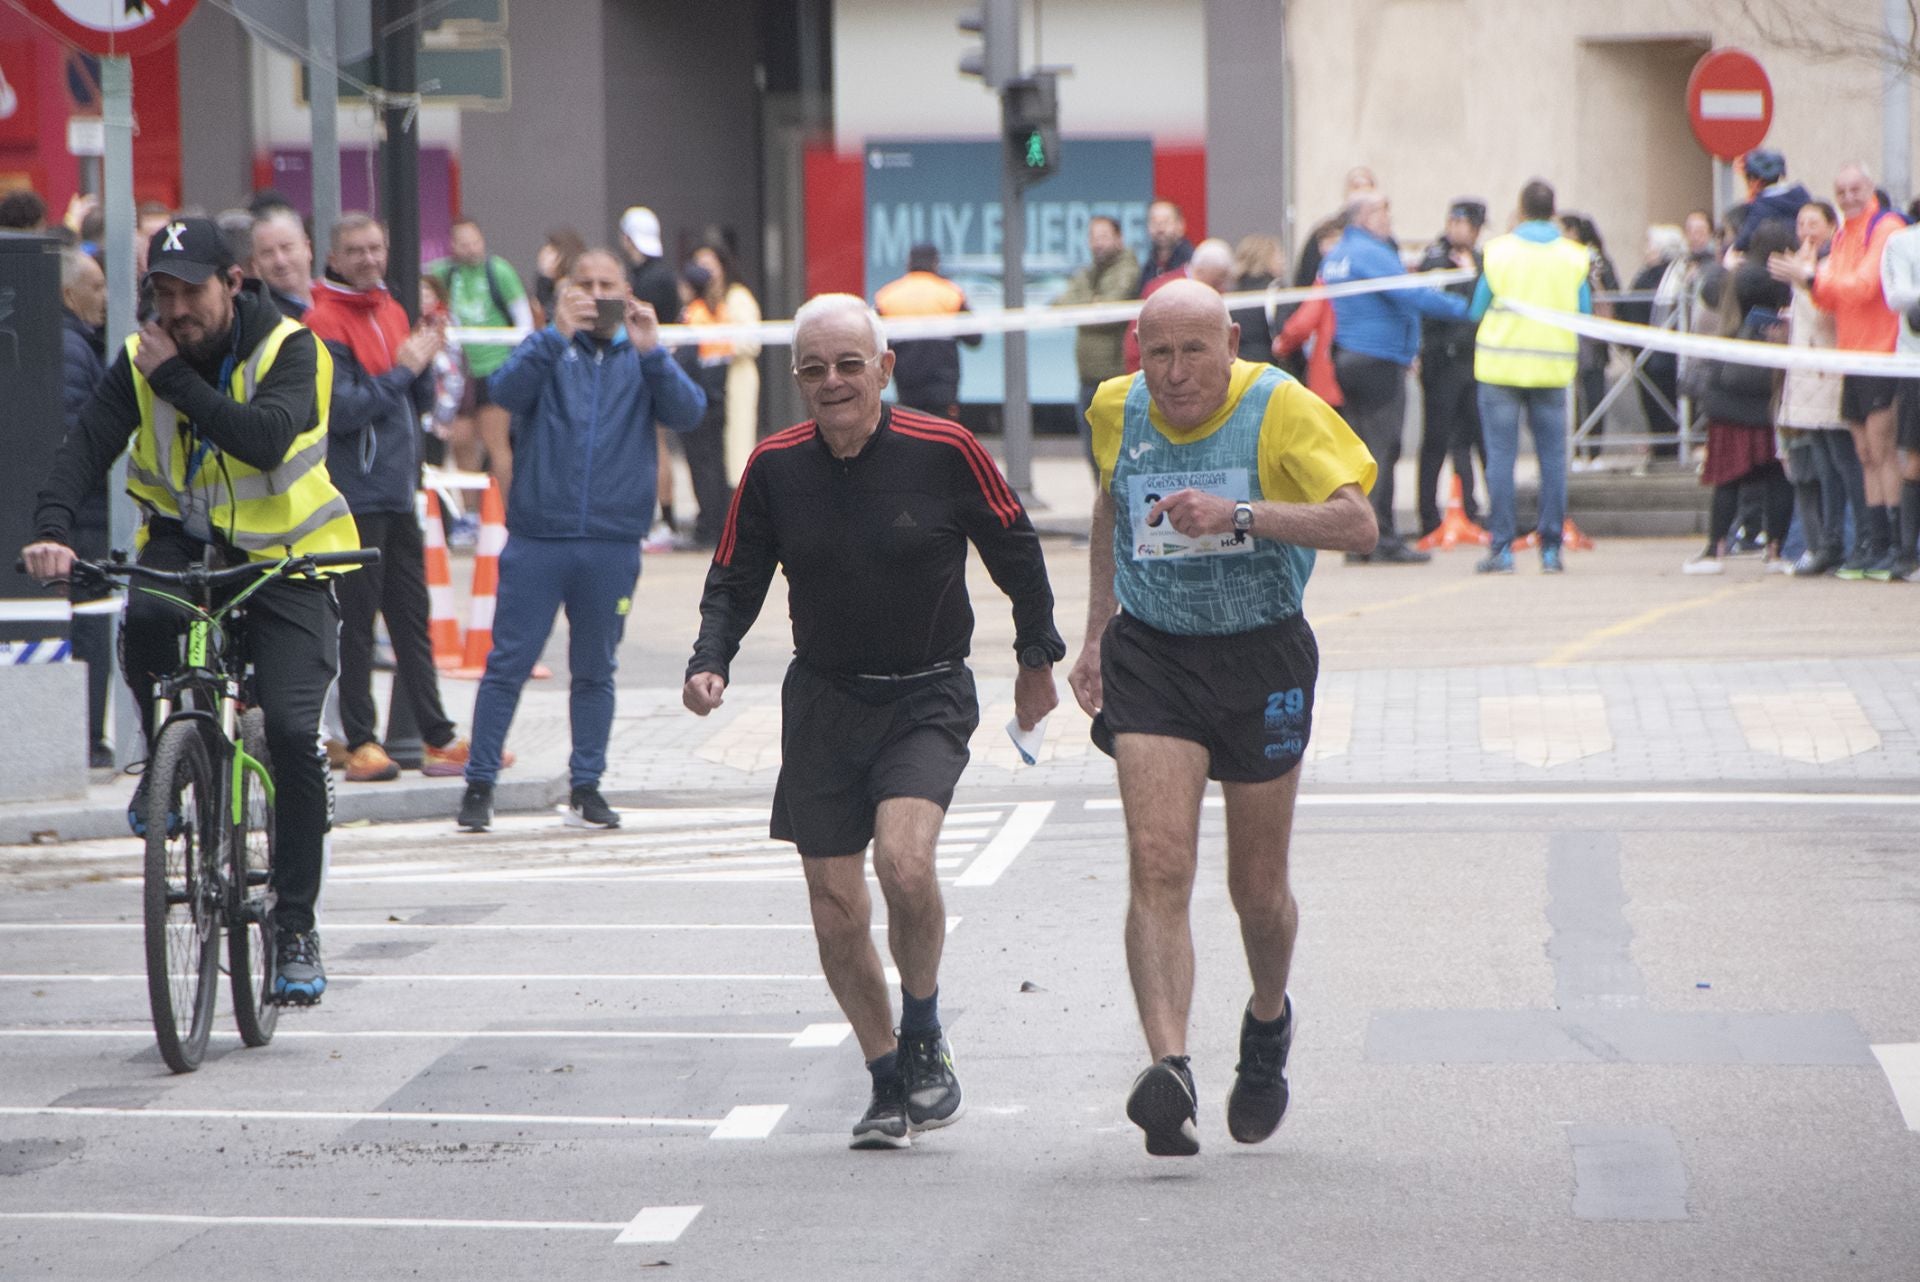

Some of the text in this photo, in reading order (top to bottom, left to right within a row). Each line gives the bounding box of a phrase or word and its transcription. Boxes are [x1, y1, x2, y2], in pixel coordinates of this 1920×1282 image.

[161, 222, 188, 251] X
[870, 201, 970, 266] MUY
[1147, 479, 1176, 488] VUELTA
[1188, 476, 1227, 486] BALUARTE
[1264, 687, 1304, 716] 29
